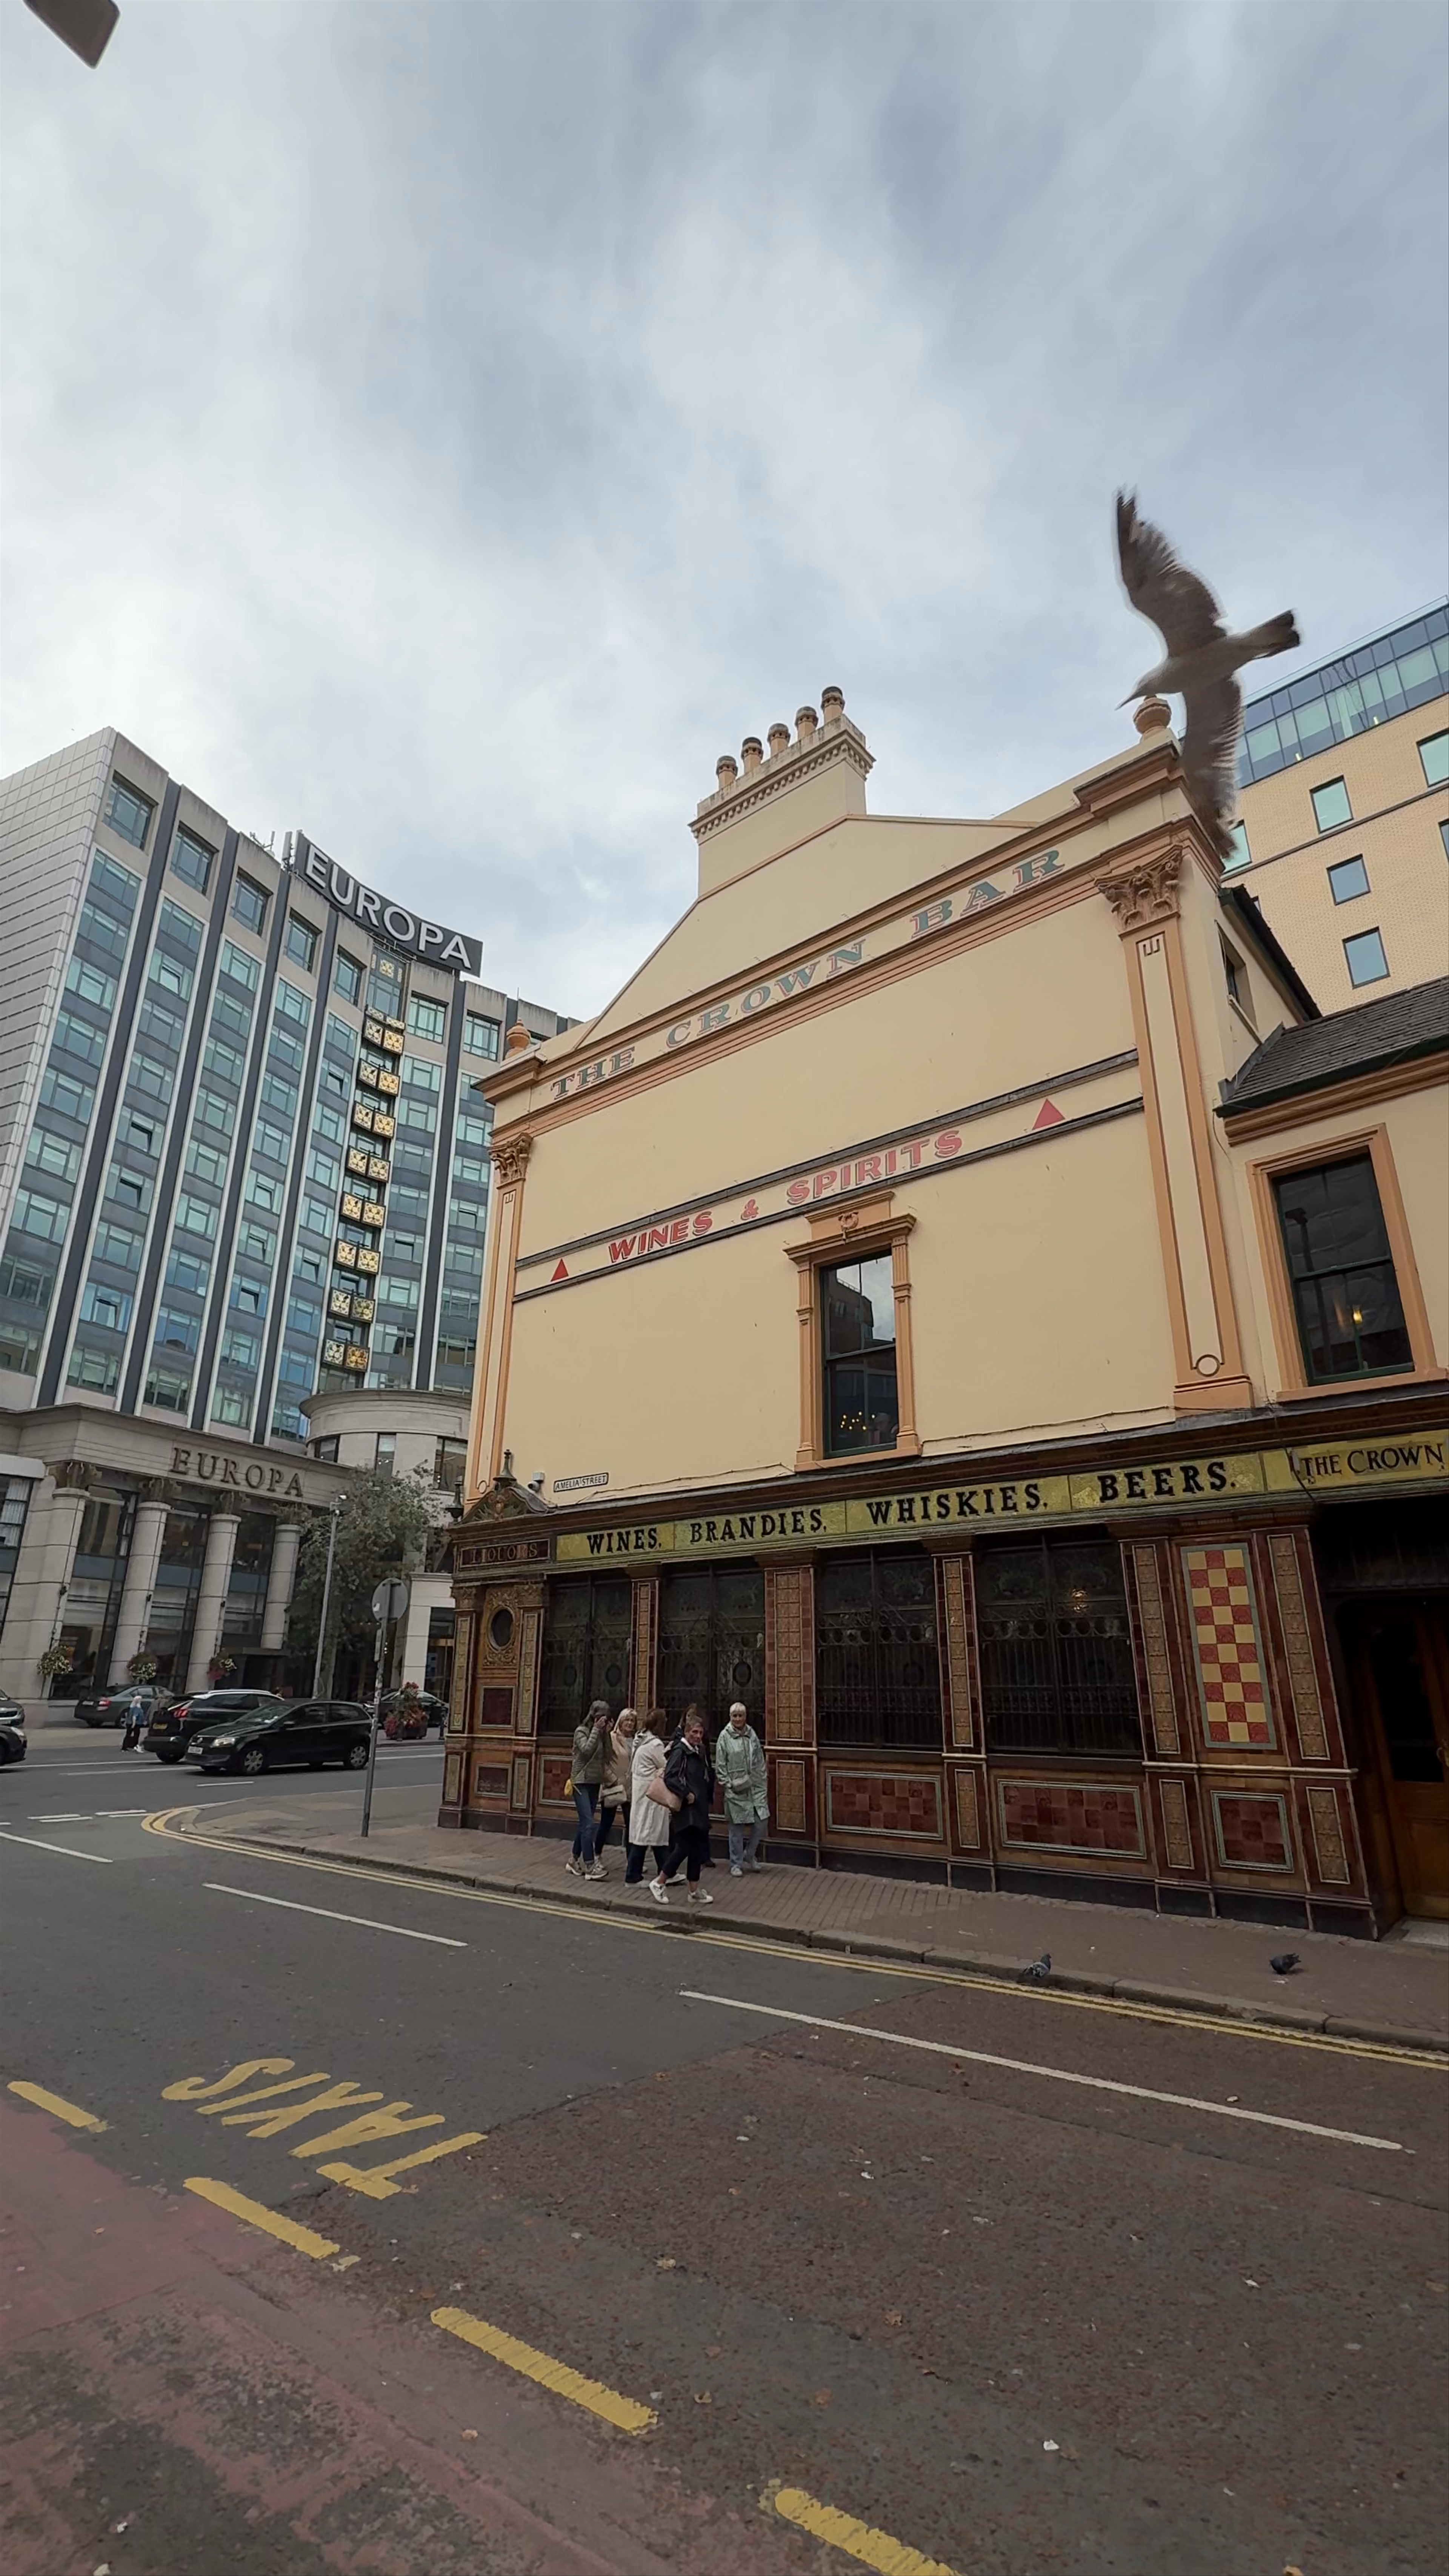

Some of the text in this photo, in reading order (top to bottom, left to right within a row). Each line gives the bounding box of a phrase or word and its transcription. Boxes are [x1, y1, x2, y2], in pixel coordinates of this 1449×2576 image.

[305, 844, 472, 969] EUROPA
[550, 848, 1067, 1101] THE CROWN BAR
[608, 1129, 963, 1264] WINES & SPIRITS
[170, 1447, 304, 1497] EUROPA
[555, 1475, 606, 1490] AMELIA STREET
[1097, 1461, 1236, 1503] BEERS.
[1301, 1443, 1444, 1476] THE CROWN
[161, 2058, 488, 2200] TAXIS
